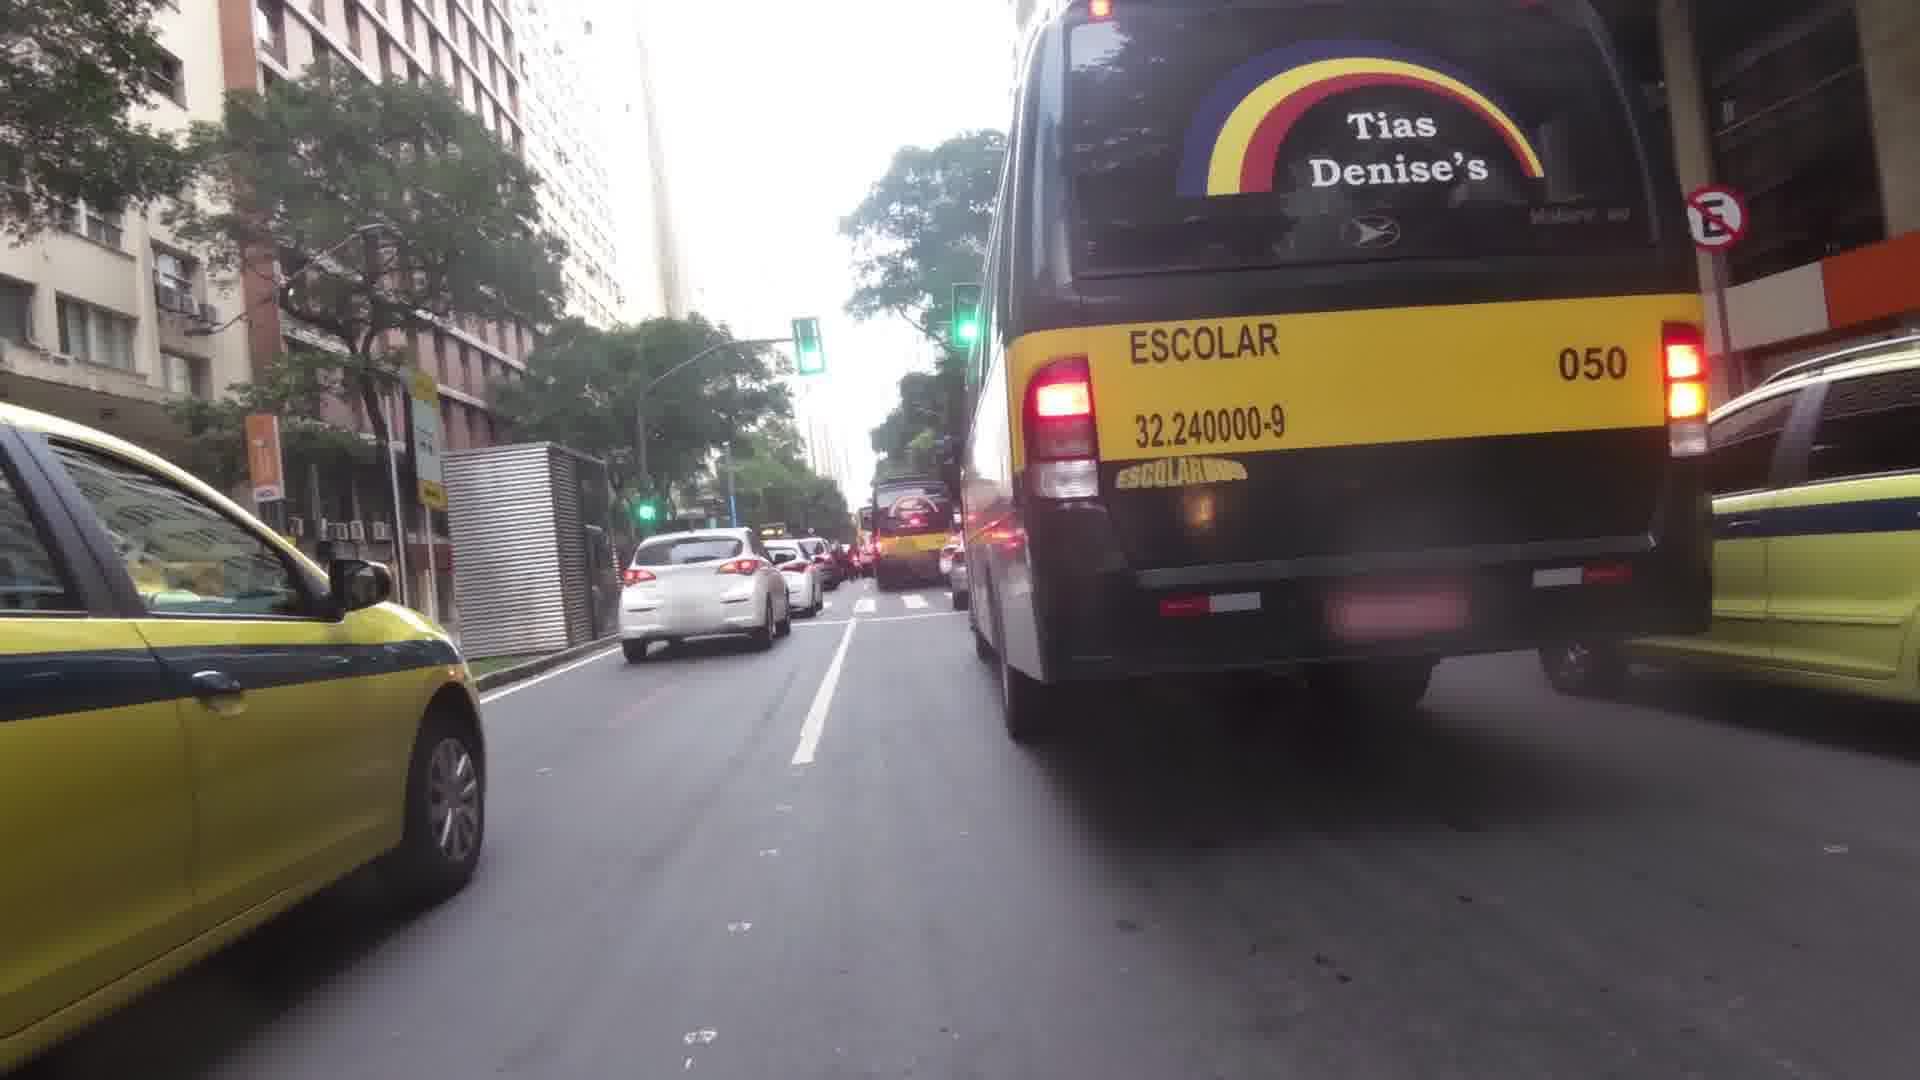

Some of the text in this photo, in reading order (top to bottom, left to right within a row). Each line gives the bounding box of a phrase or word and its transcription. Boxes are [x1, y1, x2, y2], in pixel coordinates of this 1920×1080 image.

[1347, 112, 1437, 140] Tias
[1309, 152, 1489, 187] Denise's
[1701, 199, 1728, 238] E
[1130, 323, 1280, 365] ESCOLAR
[1559, 346, 1628, 381] 050
[1135, 403, 1285, 449] 32.240000-9
